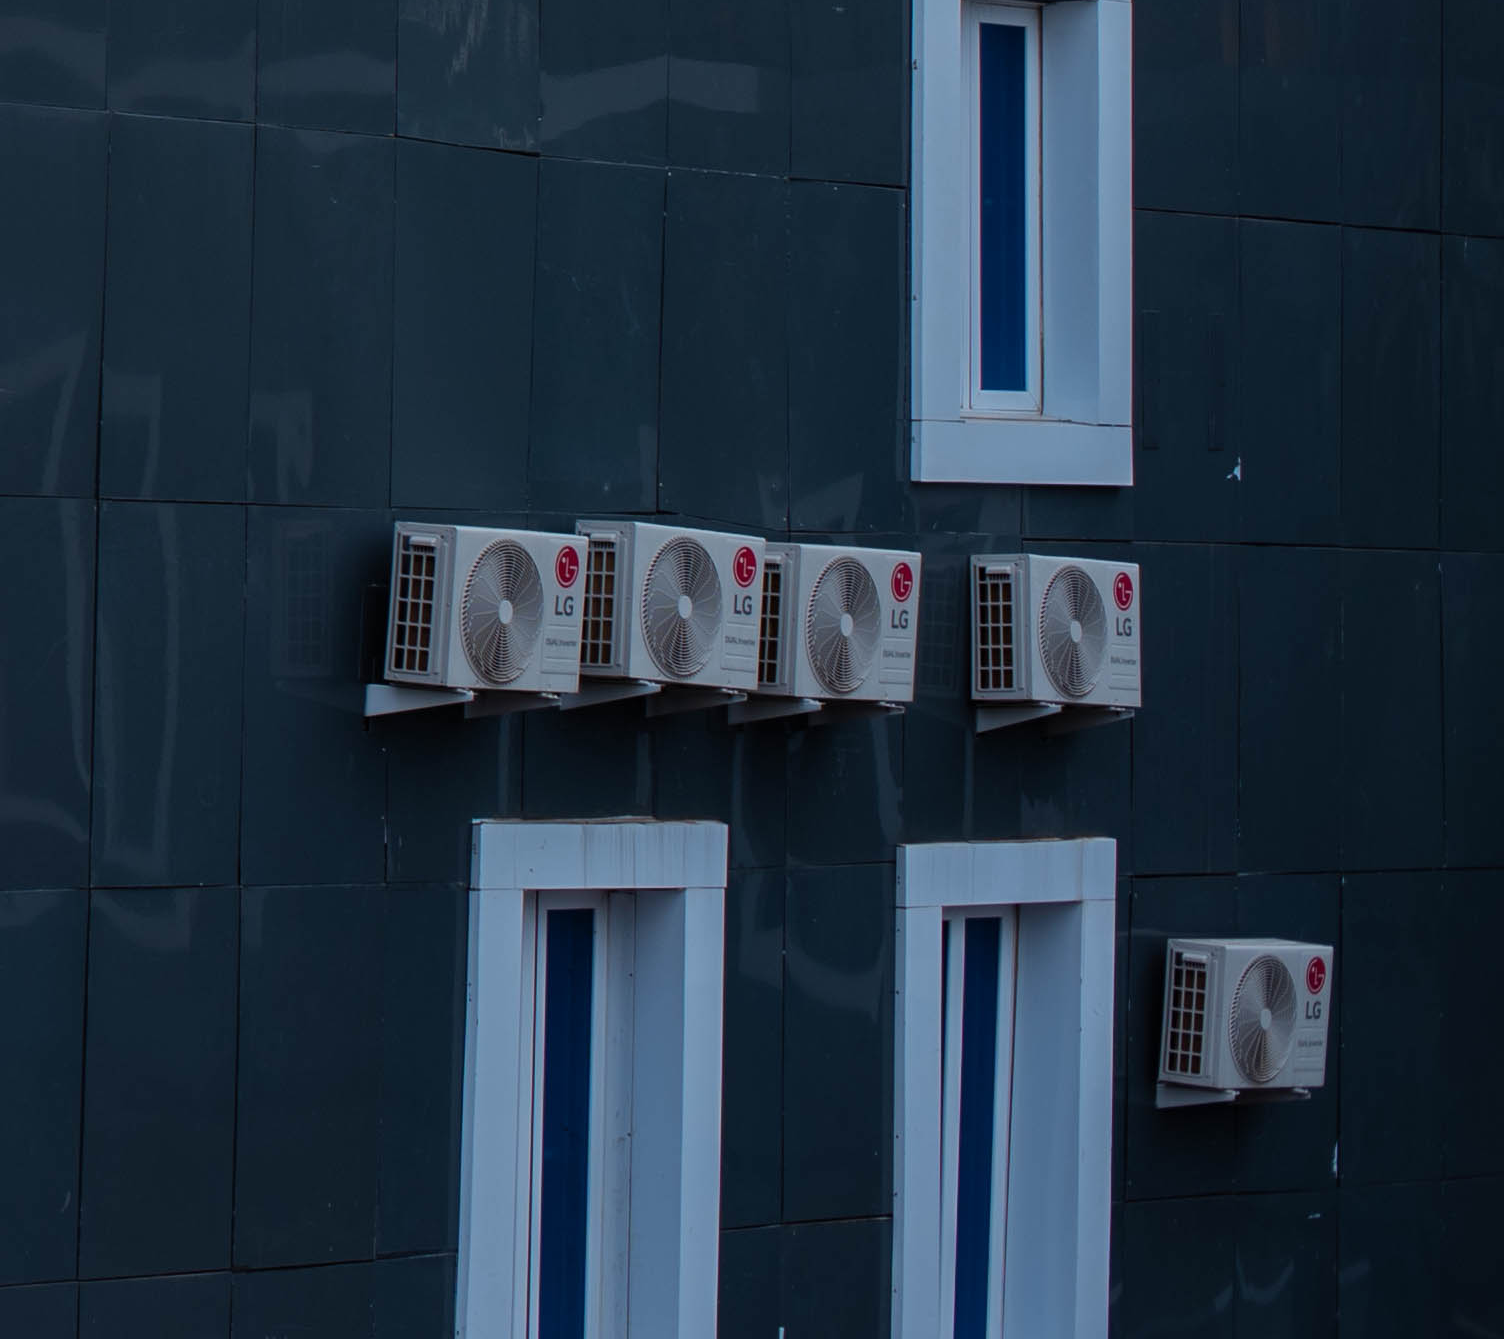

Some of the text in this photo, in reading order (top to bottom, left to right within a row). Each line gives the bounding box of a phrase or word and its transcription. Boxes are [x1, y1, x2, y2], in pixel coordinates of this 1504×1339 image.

[554, 594, 574, 617] LG
[733, 594, 753, 617] LG
[890, 609, 909, 630] LG
[1115, 617, 1132, 637] LG
[1305, 1000, 1322, 1020] LG
